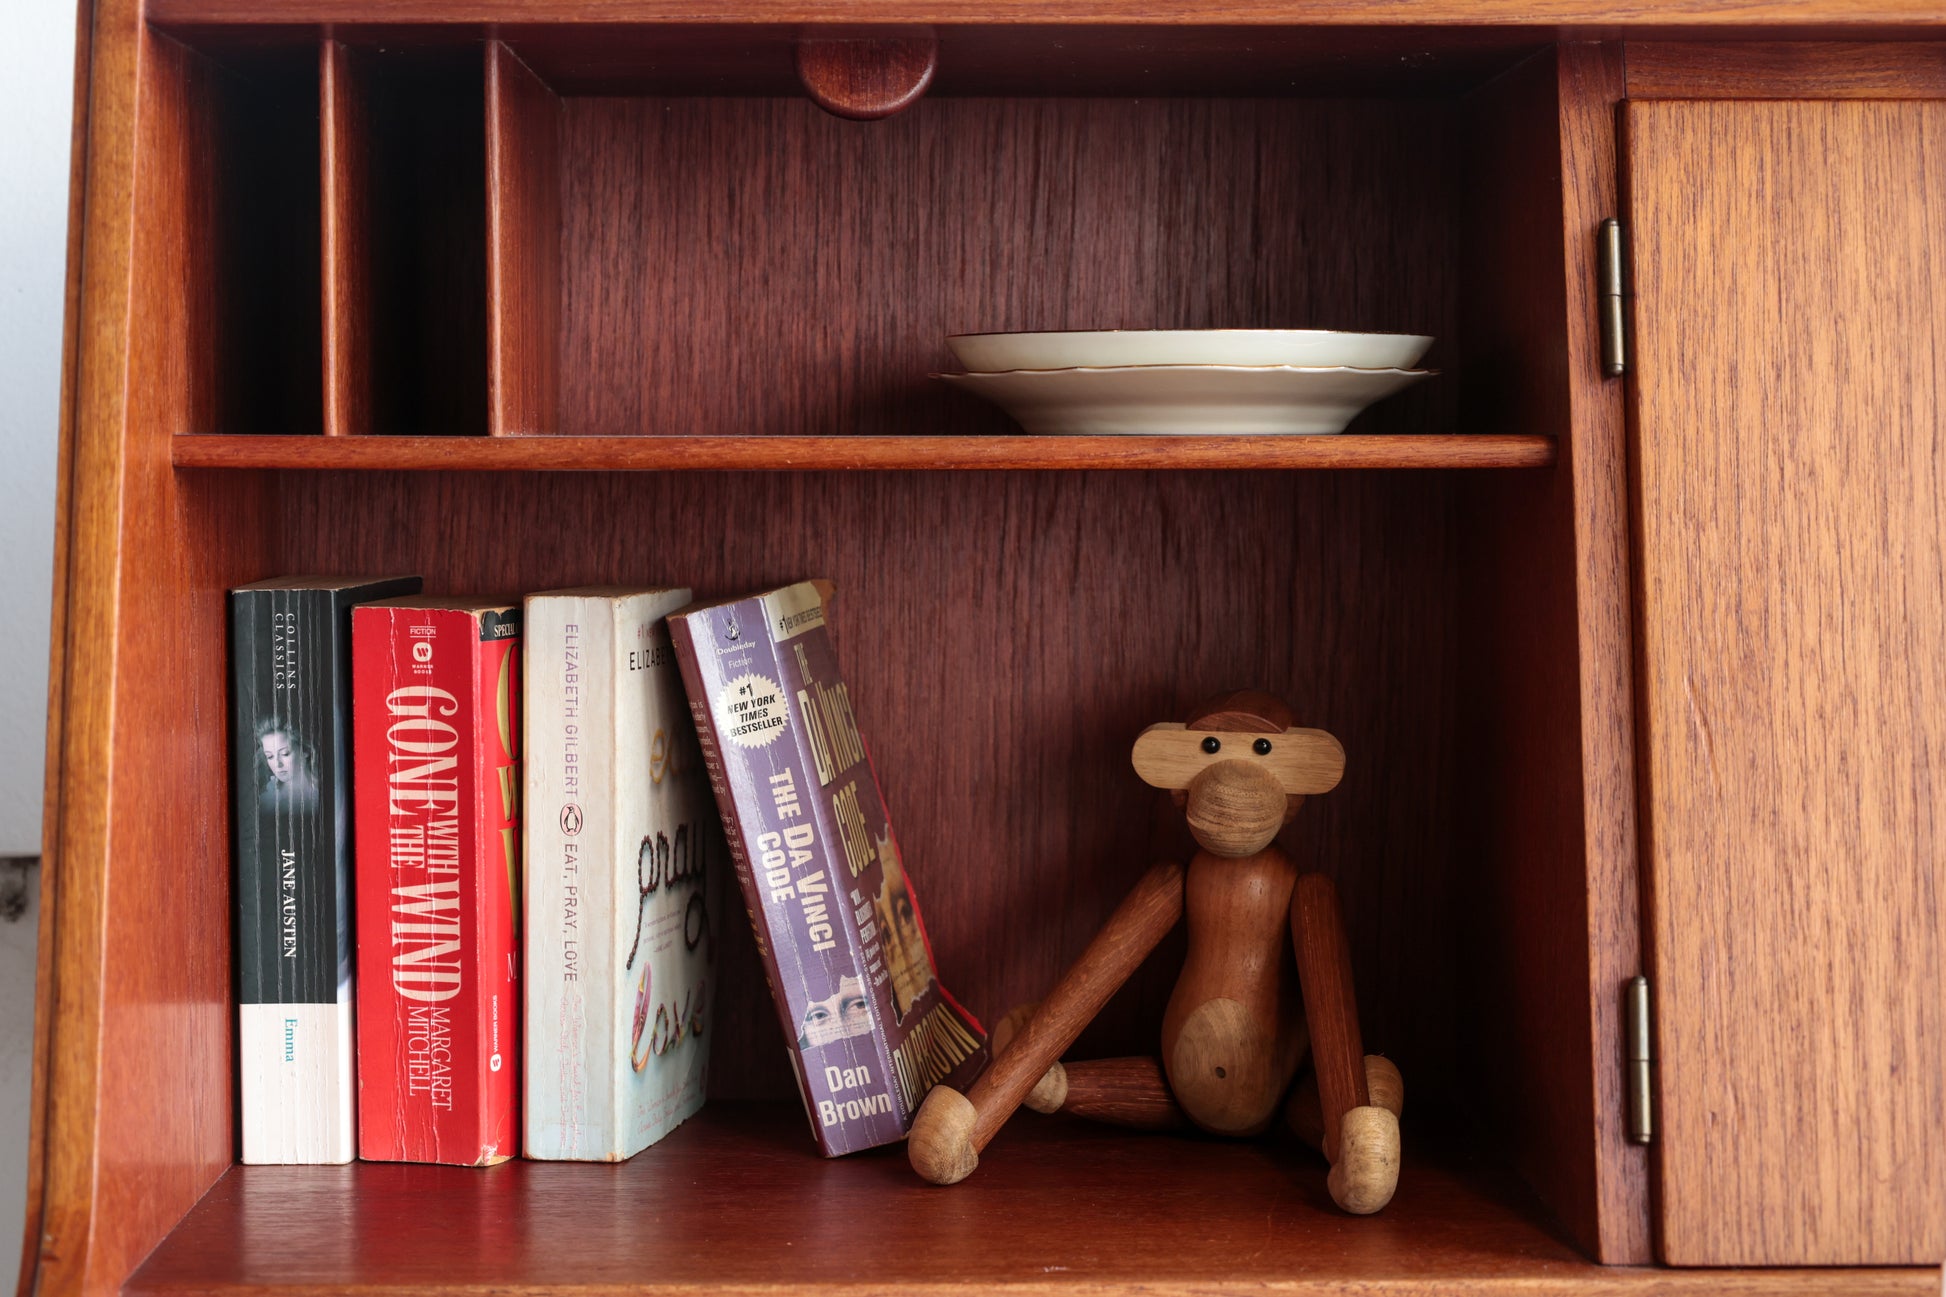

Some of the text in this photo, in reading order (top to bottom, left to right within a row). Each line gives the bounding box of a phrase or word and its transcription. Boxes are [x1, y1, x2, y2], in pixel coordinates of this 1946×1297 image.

[274, 613, 285, 689] CLASSICS
[286, 613, 296, 689] COLLINS
[716, 640, 756, 656] Doubleday
[728, 656, 752, 668] Fiction
[565, 624, 578, 797] ELIZABETH GILBERT
[727, 694, 776, 714] NEW YORK
[739, 683, 753, 696] #1
[739, 708, 769, 723] TIMES
[730, 716, 783, 738] BESTSELLER
[386, 686, 459, 874] GONE WITH
[768, 767, 836, 952] THE DA VINCI
[832, 780, 876, 879] CODE
[756, 831, 796, 904] CODE
[281, 849, 297, 958] JANE AUSTEN
[390, 825, 462, 1002] THE WIND
[562, 886, 577, 933] PRAY,
[564, 941, 577, 981] LOVE
[285, 1018, 298, 1062] Emma
[408, 1006, 430, 1096] MITCHELL
[430, 1006, 452, 1111] MARGARET
[491, 1021, 499, 1052] WARNER
[909, 1002, 981, 1090] BROWN
[825, 1065, 871, 1093] Dan
[818, 1092, 893, 1127] Brown
